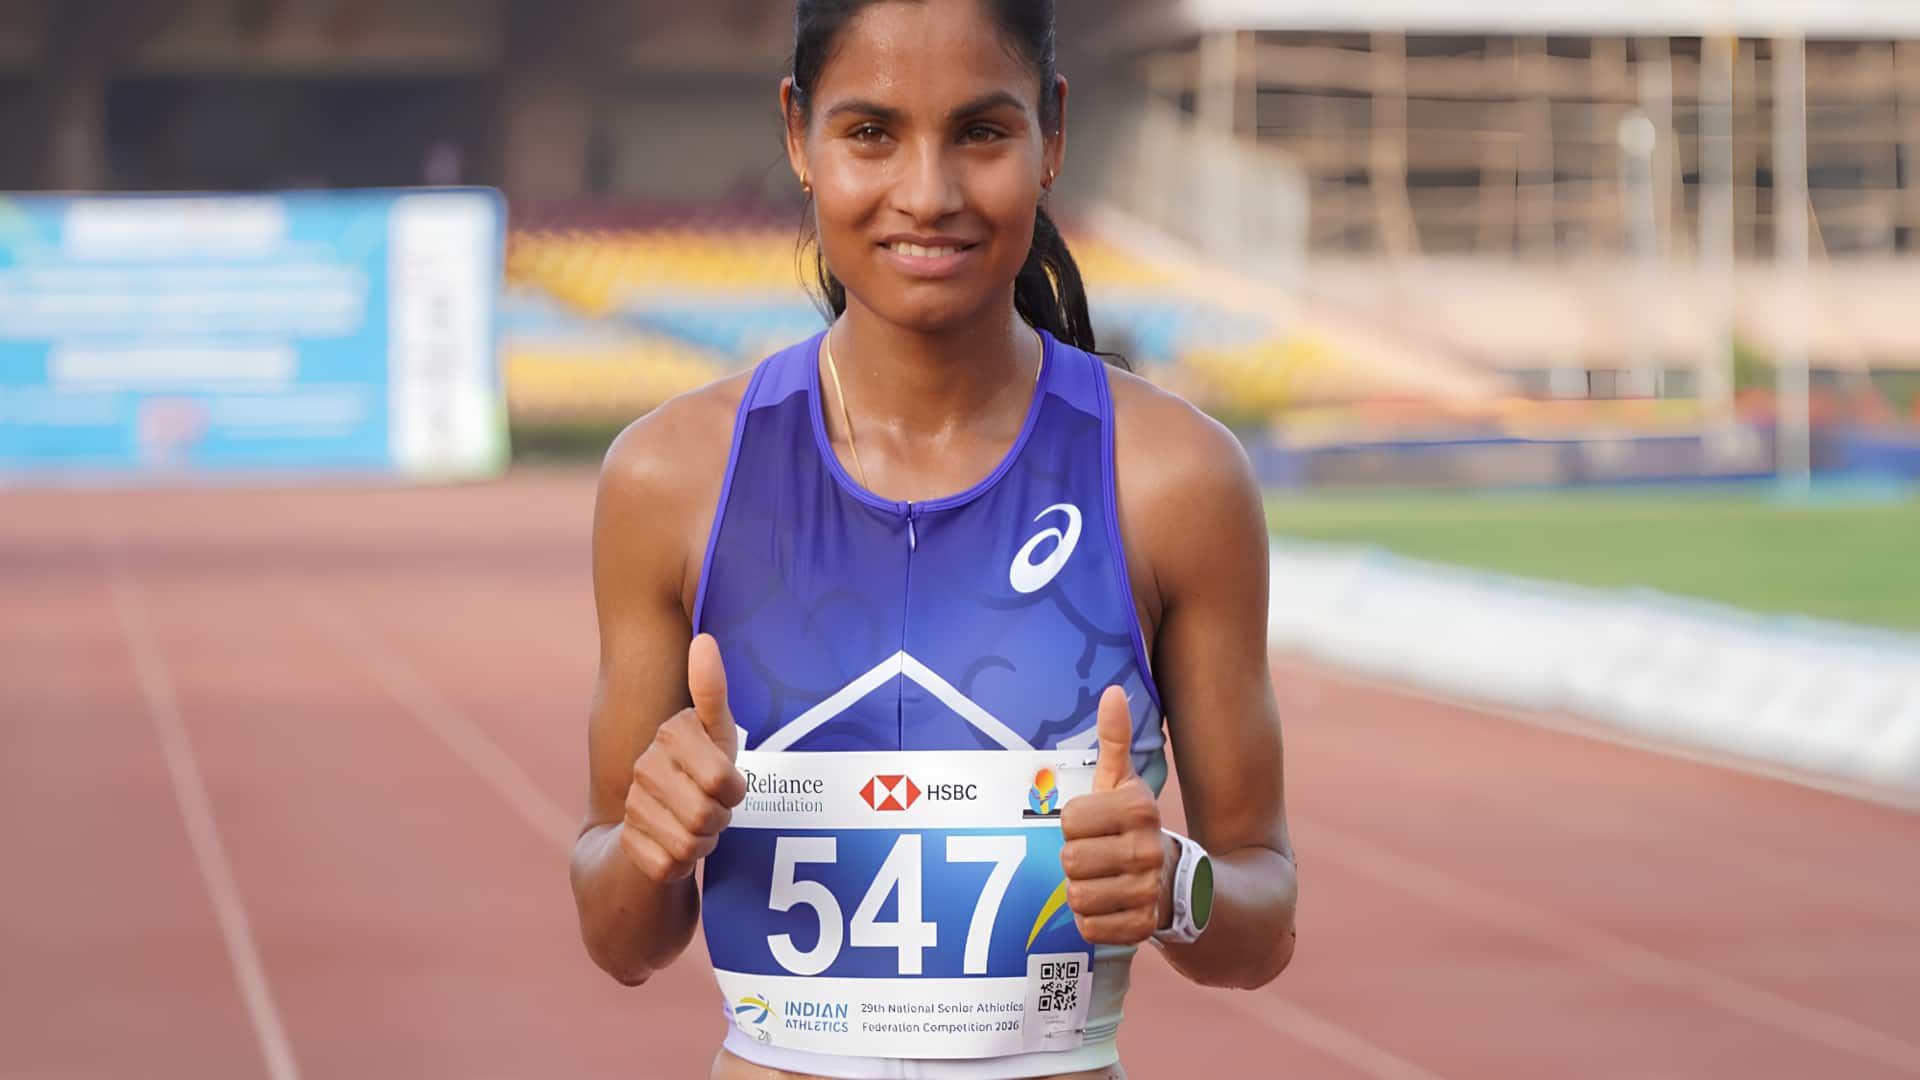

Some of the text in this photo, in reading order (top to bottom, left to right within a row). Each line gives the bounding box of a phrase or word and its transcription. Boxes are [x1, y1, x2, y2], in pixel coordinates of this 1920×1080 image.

[746, 772, 824, 794] Reliance
[927, 784, 978, 801] HSBC
[744, 797, 824, 813] Foundation
[767, 833, 1027, 976] 547
[785, 1001, 849, 1019] INDIAN
[860, 1001, 1024, 1013] 29th National Senior Athletics
[785, 1019, 849, 1033] ATHLETICS
[862, 1022, 920, 1032] Federation
[922, 1022, 993, 1034] Competition
